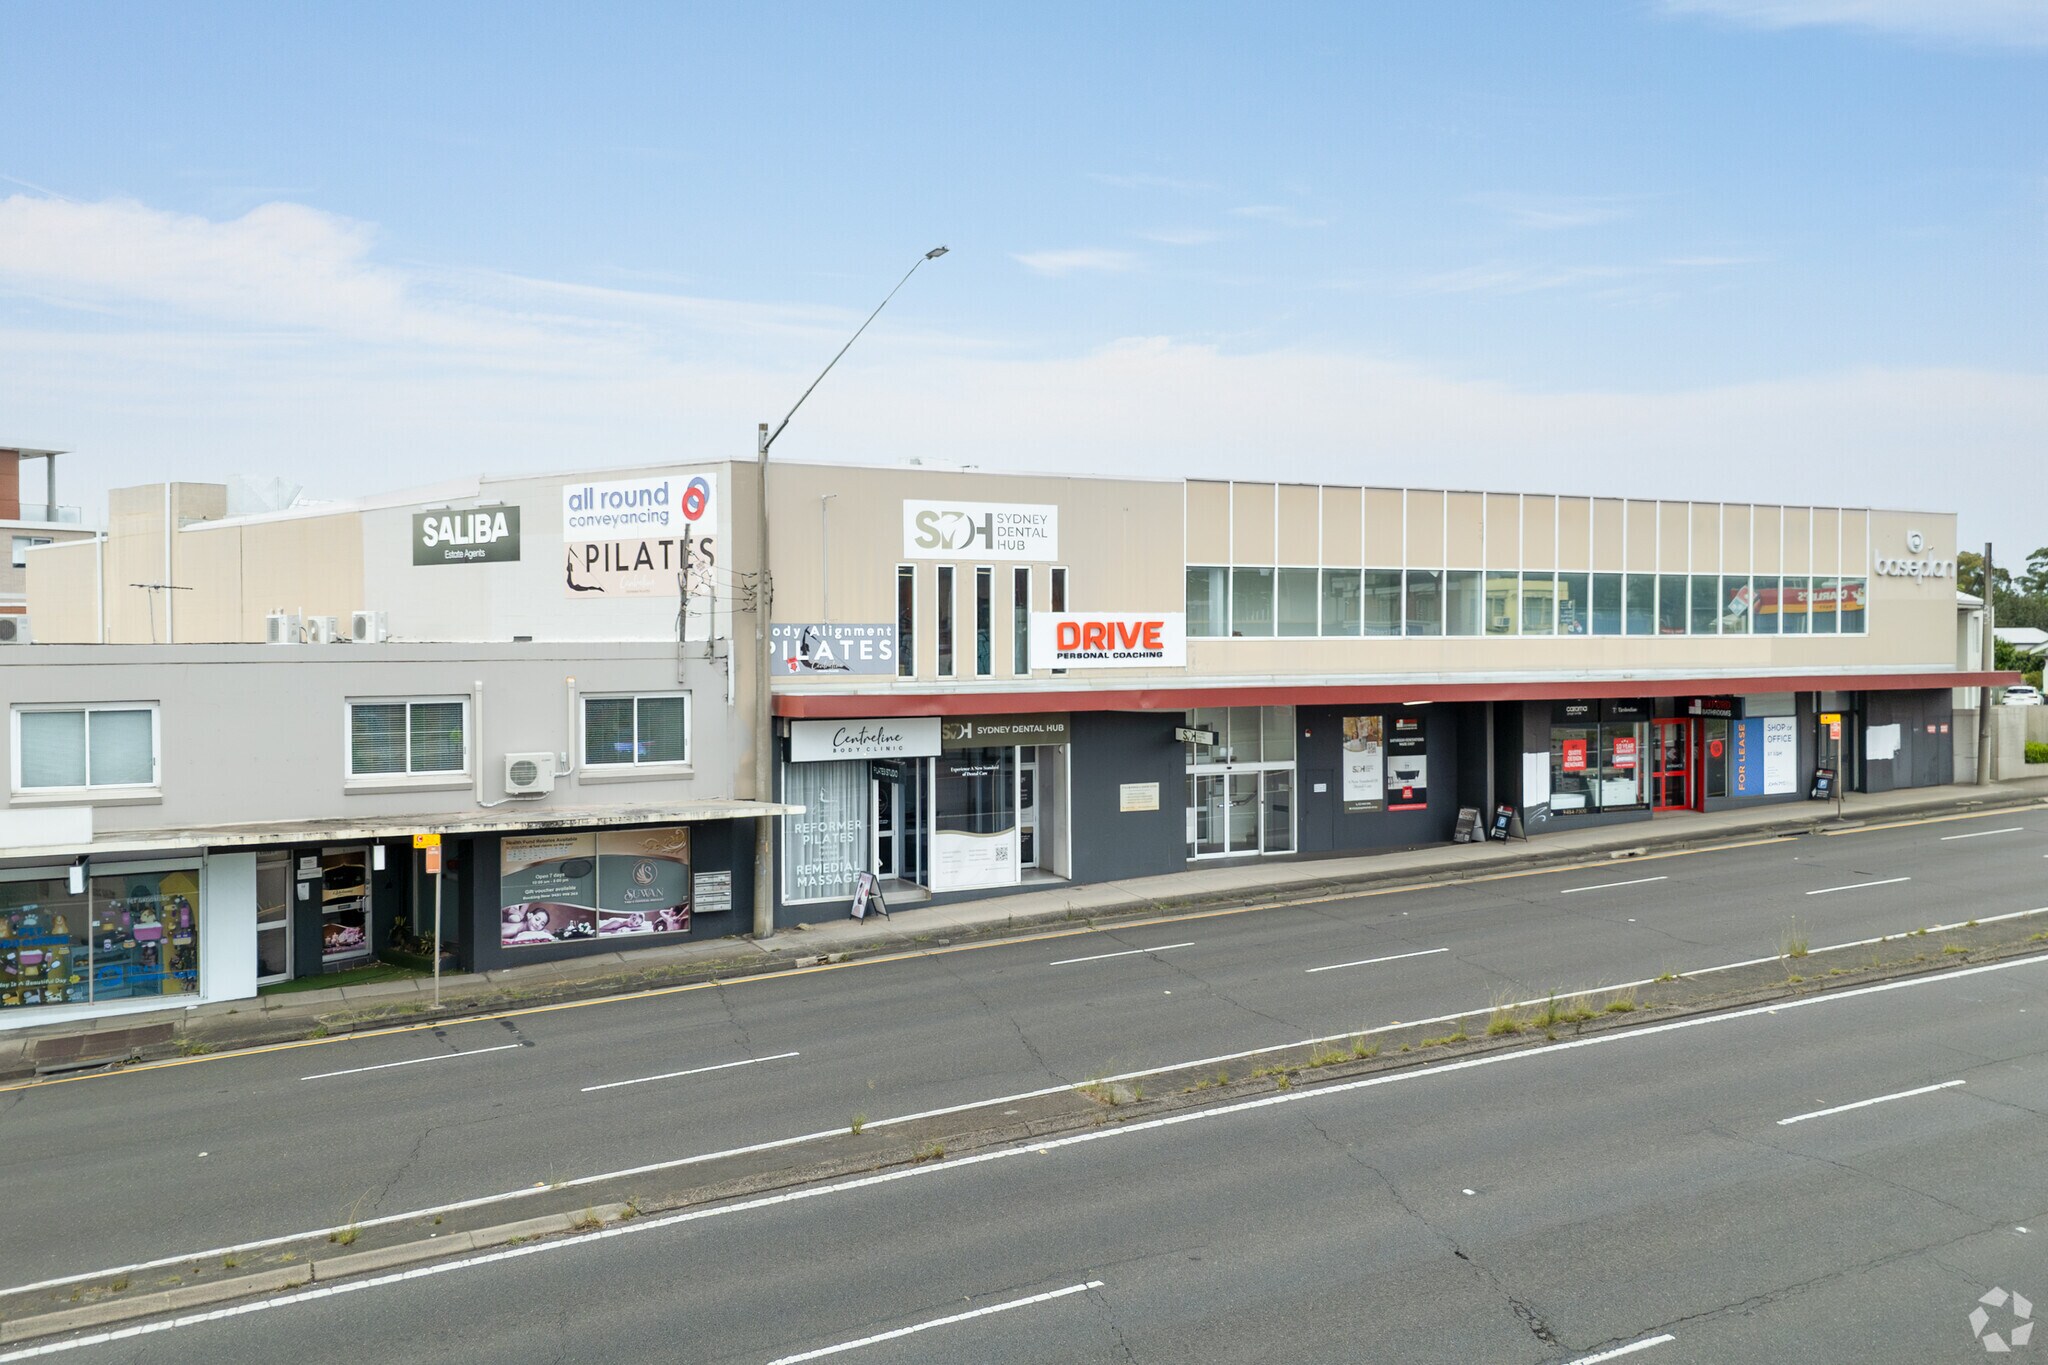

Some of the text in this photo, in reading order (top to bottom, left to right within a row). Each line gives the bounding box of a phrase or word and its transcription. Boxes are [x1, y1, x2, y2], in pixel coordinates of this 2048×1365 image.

[569, 481, 669, 512] all round
[569, 508, 669, 528] conveyancing
[997, 513, 1048, 525] SYDNEY
[422, 512, 509, 547] SALIBA
[997, 526, 1048, 538] DENTAL
[997, 540, 1025, 550] HUB
[444, 549, 486, 560] Estate Agents
[586, 537, 715, 573] PILATES
[1874, 548, 1955, 585] baseplan
[770, 625, 892, 639] ody Alignment
[1056, 621, 1165, 651] DRIVE
[1113, 651, 1163, 659] COACHING
[977, 725, 1010, 735] SYDNEY
[1012, 724, 1044, 733] DENTAL
[1046, 724, 1064, 732] HUB
[1767, 724, 1786, 732] SHOP
[833, 726, 903, 747] Centreline
[1767, 734, 1792, 743] OFFICE
[1738, 723, 1746, 790] FOR LEASE
[794, 820, 862, 834] REFORMER
[803, 832, 854, 845] PILATES
[796, 861, 861, 876] REMEDIAL
[797, 872, 860, 888] MASSAGE
